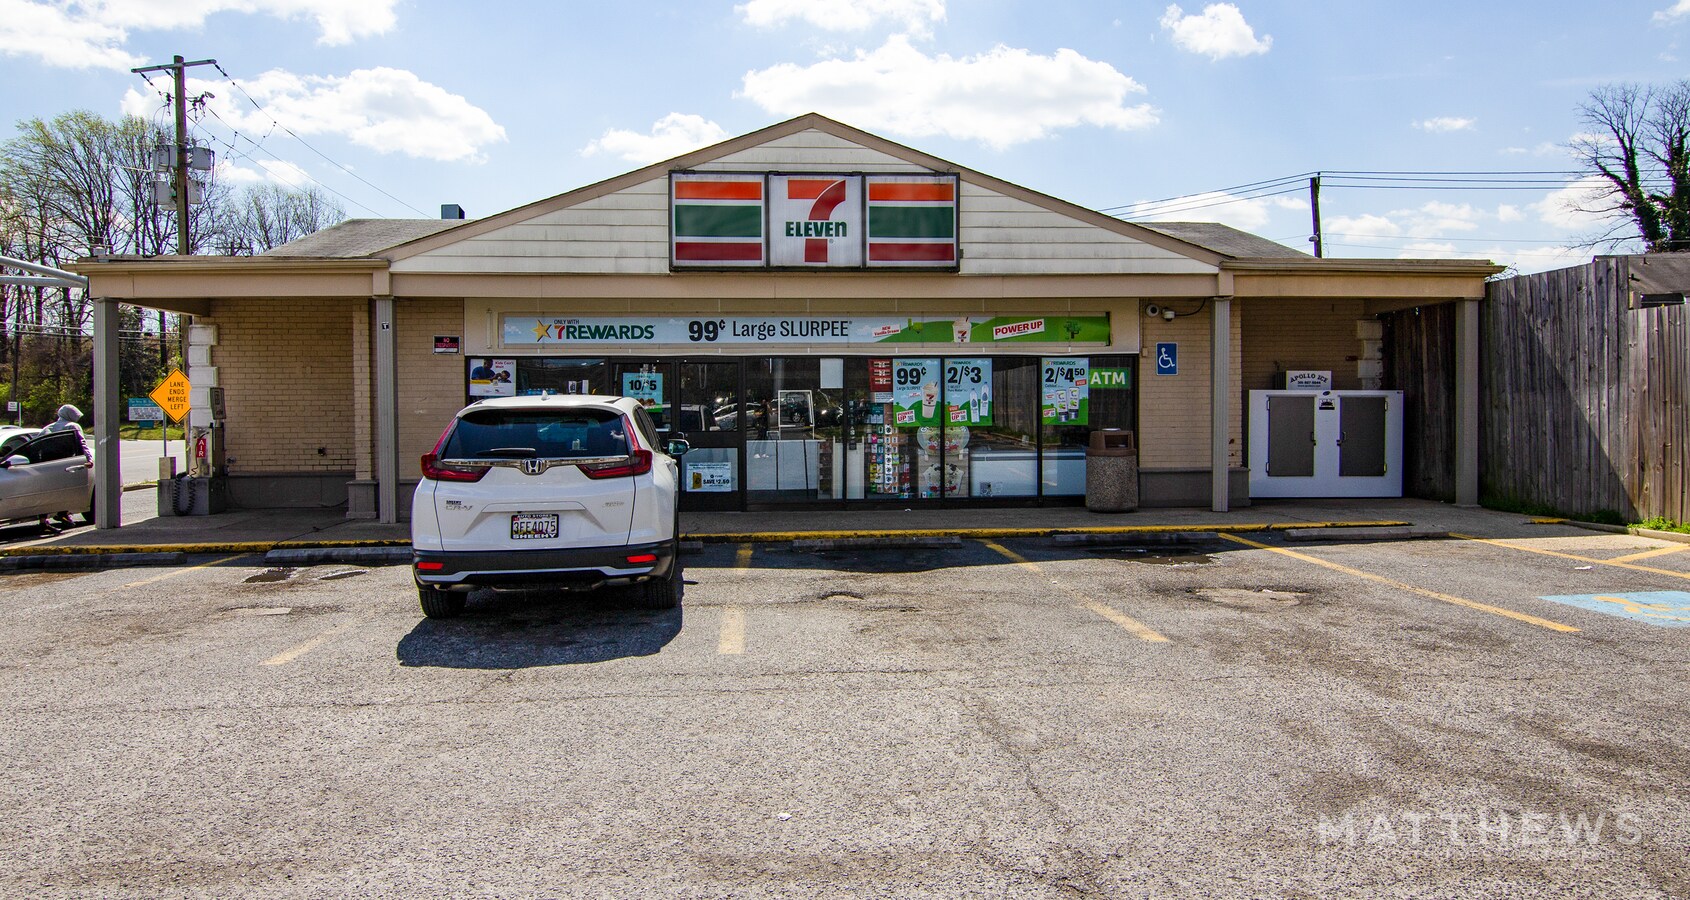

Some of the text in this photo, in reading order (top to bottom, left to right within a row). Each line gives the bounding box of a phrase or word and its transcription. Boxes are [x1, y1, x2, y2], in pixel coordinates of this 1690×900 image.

[732, 320, 776, 340] Large
[780, 320, 849, 337] SLURPEE
[994, 320, 1043, 336] POWER UP
[947, 365, 982, 385] 2/$3
[1090, 371, 1126, 385] ATM
[1290, 373, 1329, 384] APOLLO ICE
